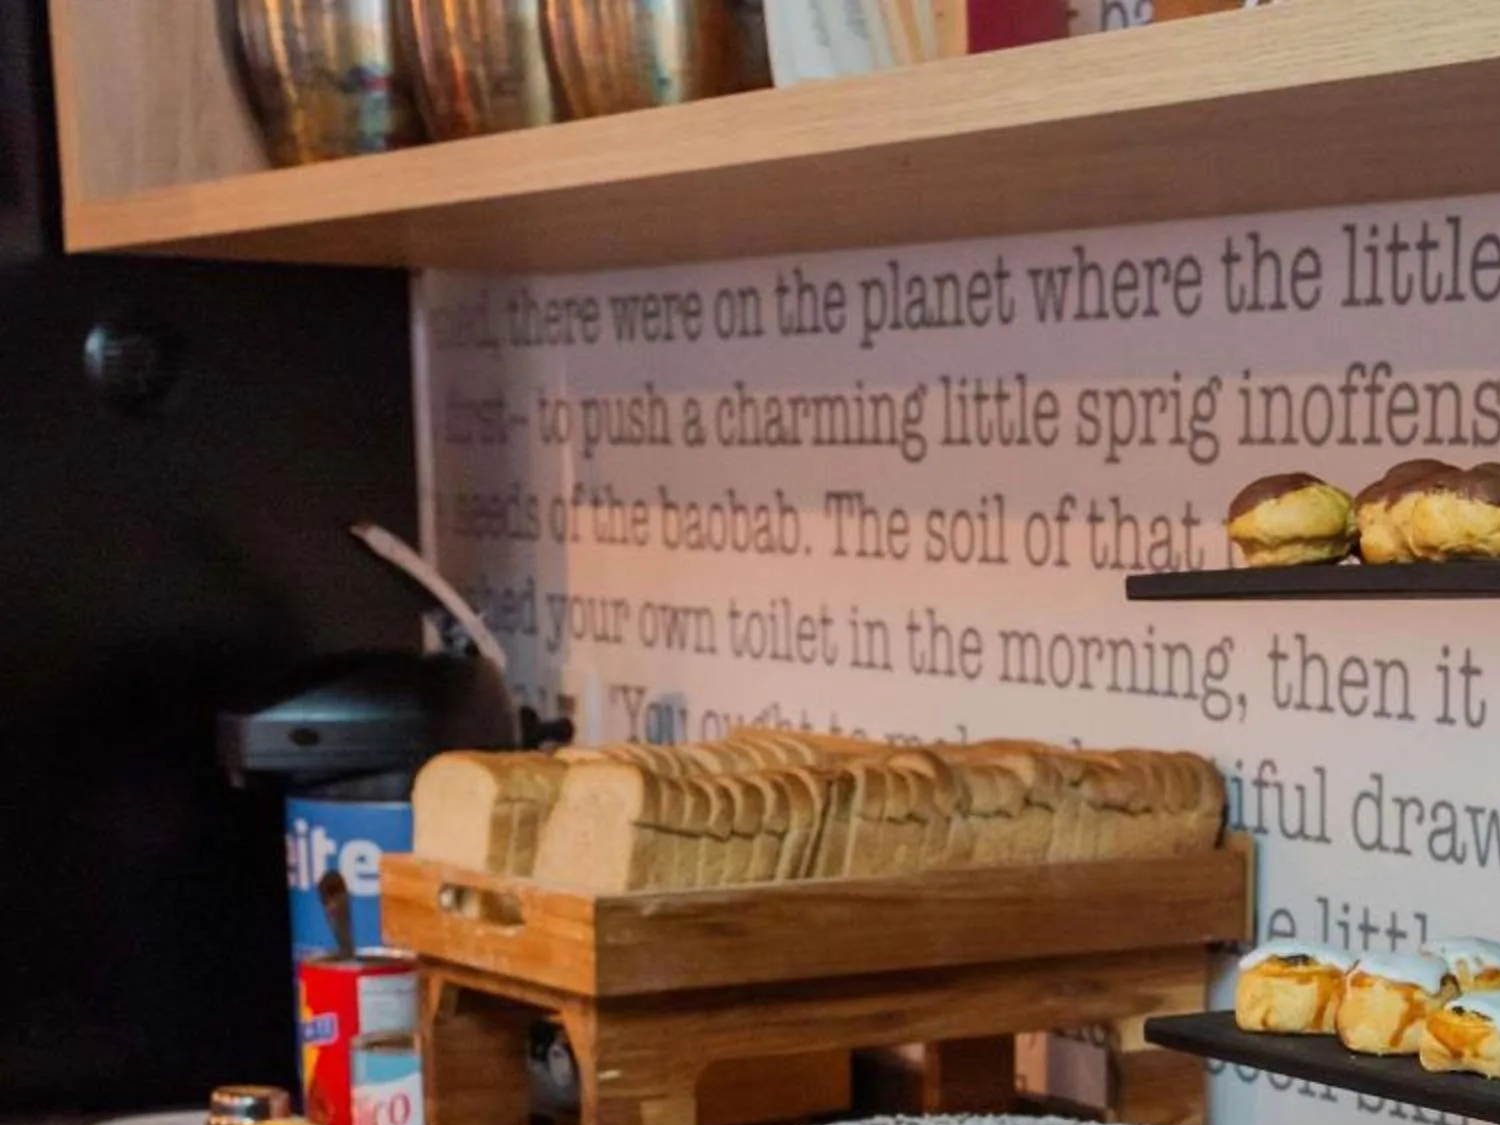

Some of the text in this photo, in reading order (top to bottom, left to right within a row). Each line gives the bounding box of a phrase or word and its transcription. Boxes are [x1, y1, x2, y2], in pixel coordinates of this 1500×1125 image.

[608, 292, 705, 342] were
[714, 289, 764, 339] on
[774, 268, 848, 337] the
[858, 255, 1018, 349] planet
[1026, 245, 1203, 324] where
[1222, 231, 1323, 312] the
[537, 389, 573, 446] to
[582, 383, 672, 458] push
[682, 397, 706, 446] a
[716, 380, 928, 463] charming
[938, 374, 1062, 449] little
[1075, 372, 1223, 466] sprig
[551, 481, 583, 544] of
[590, 482, 650, 546] the
[658, 484, 812, 556] baobab.
[825, 490, 910, 561] The
[924, 495, 1008, 565] soil
[1023, 497, 1076, 570] of
[1083, 496, 1206, 572] that
[546, 591, 631, 656] your
[638, 599, 717, 655] own
[727, 597, 839, 669] toilet
[850, 606, 895, 674] in
[906, 606, 984, 682] the
[998, 624, 1249, 724] morning,
[1266, 633, 1416, 724] then
[1434, 644, 1488, 730] it
